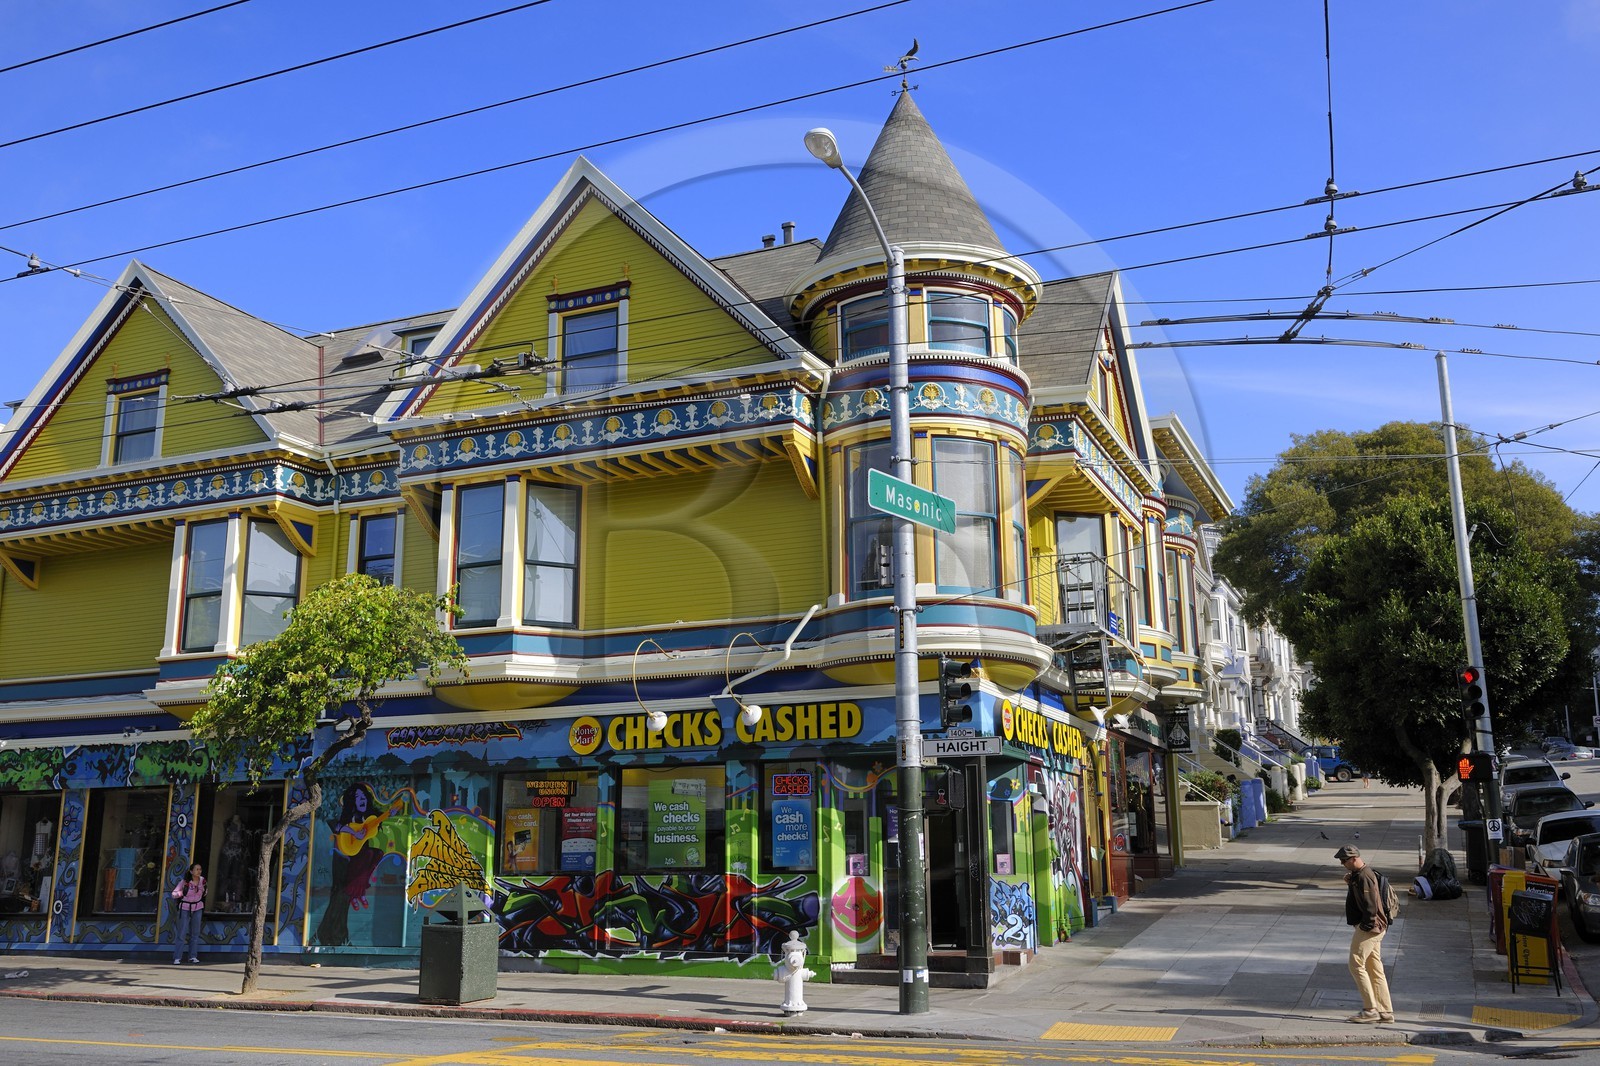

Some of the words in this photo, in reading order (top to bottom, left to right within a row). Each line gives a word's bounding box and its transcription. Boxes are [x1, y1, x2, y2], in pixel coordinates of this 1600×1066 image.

[886, 484, 942, 522] Masonic
[735, 702, 862, 743] CASHED
[572, 725, 599, 737] Money
[951, 729, 967, 737] 1400
[1015, 706, 1049, 750] CHECKS
[1053, 720, 1082, 759] CASHED
[573, 736, 596, 745] Mart
[936, 740, 988, 753] HAIGHT
[775, 776, 809, 785] CHECKS
[774, 785, 810, 794] CASHED
[532, 796, 566, 807] OPEN
[654, 802, 667, 812] We
[669, 802, 689, 811] cash
[663, 812, 700, 823] checks
[775, 811, 804, 824] cash
[785, 823, 808, 831] more
[654, 833, 699, 843] business.
[777, 832, 809, 841] checks!
